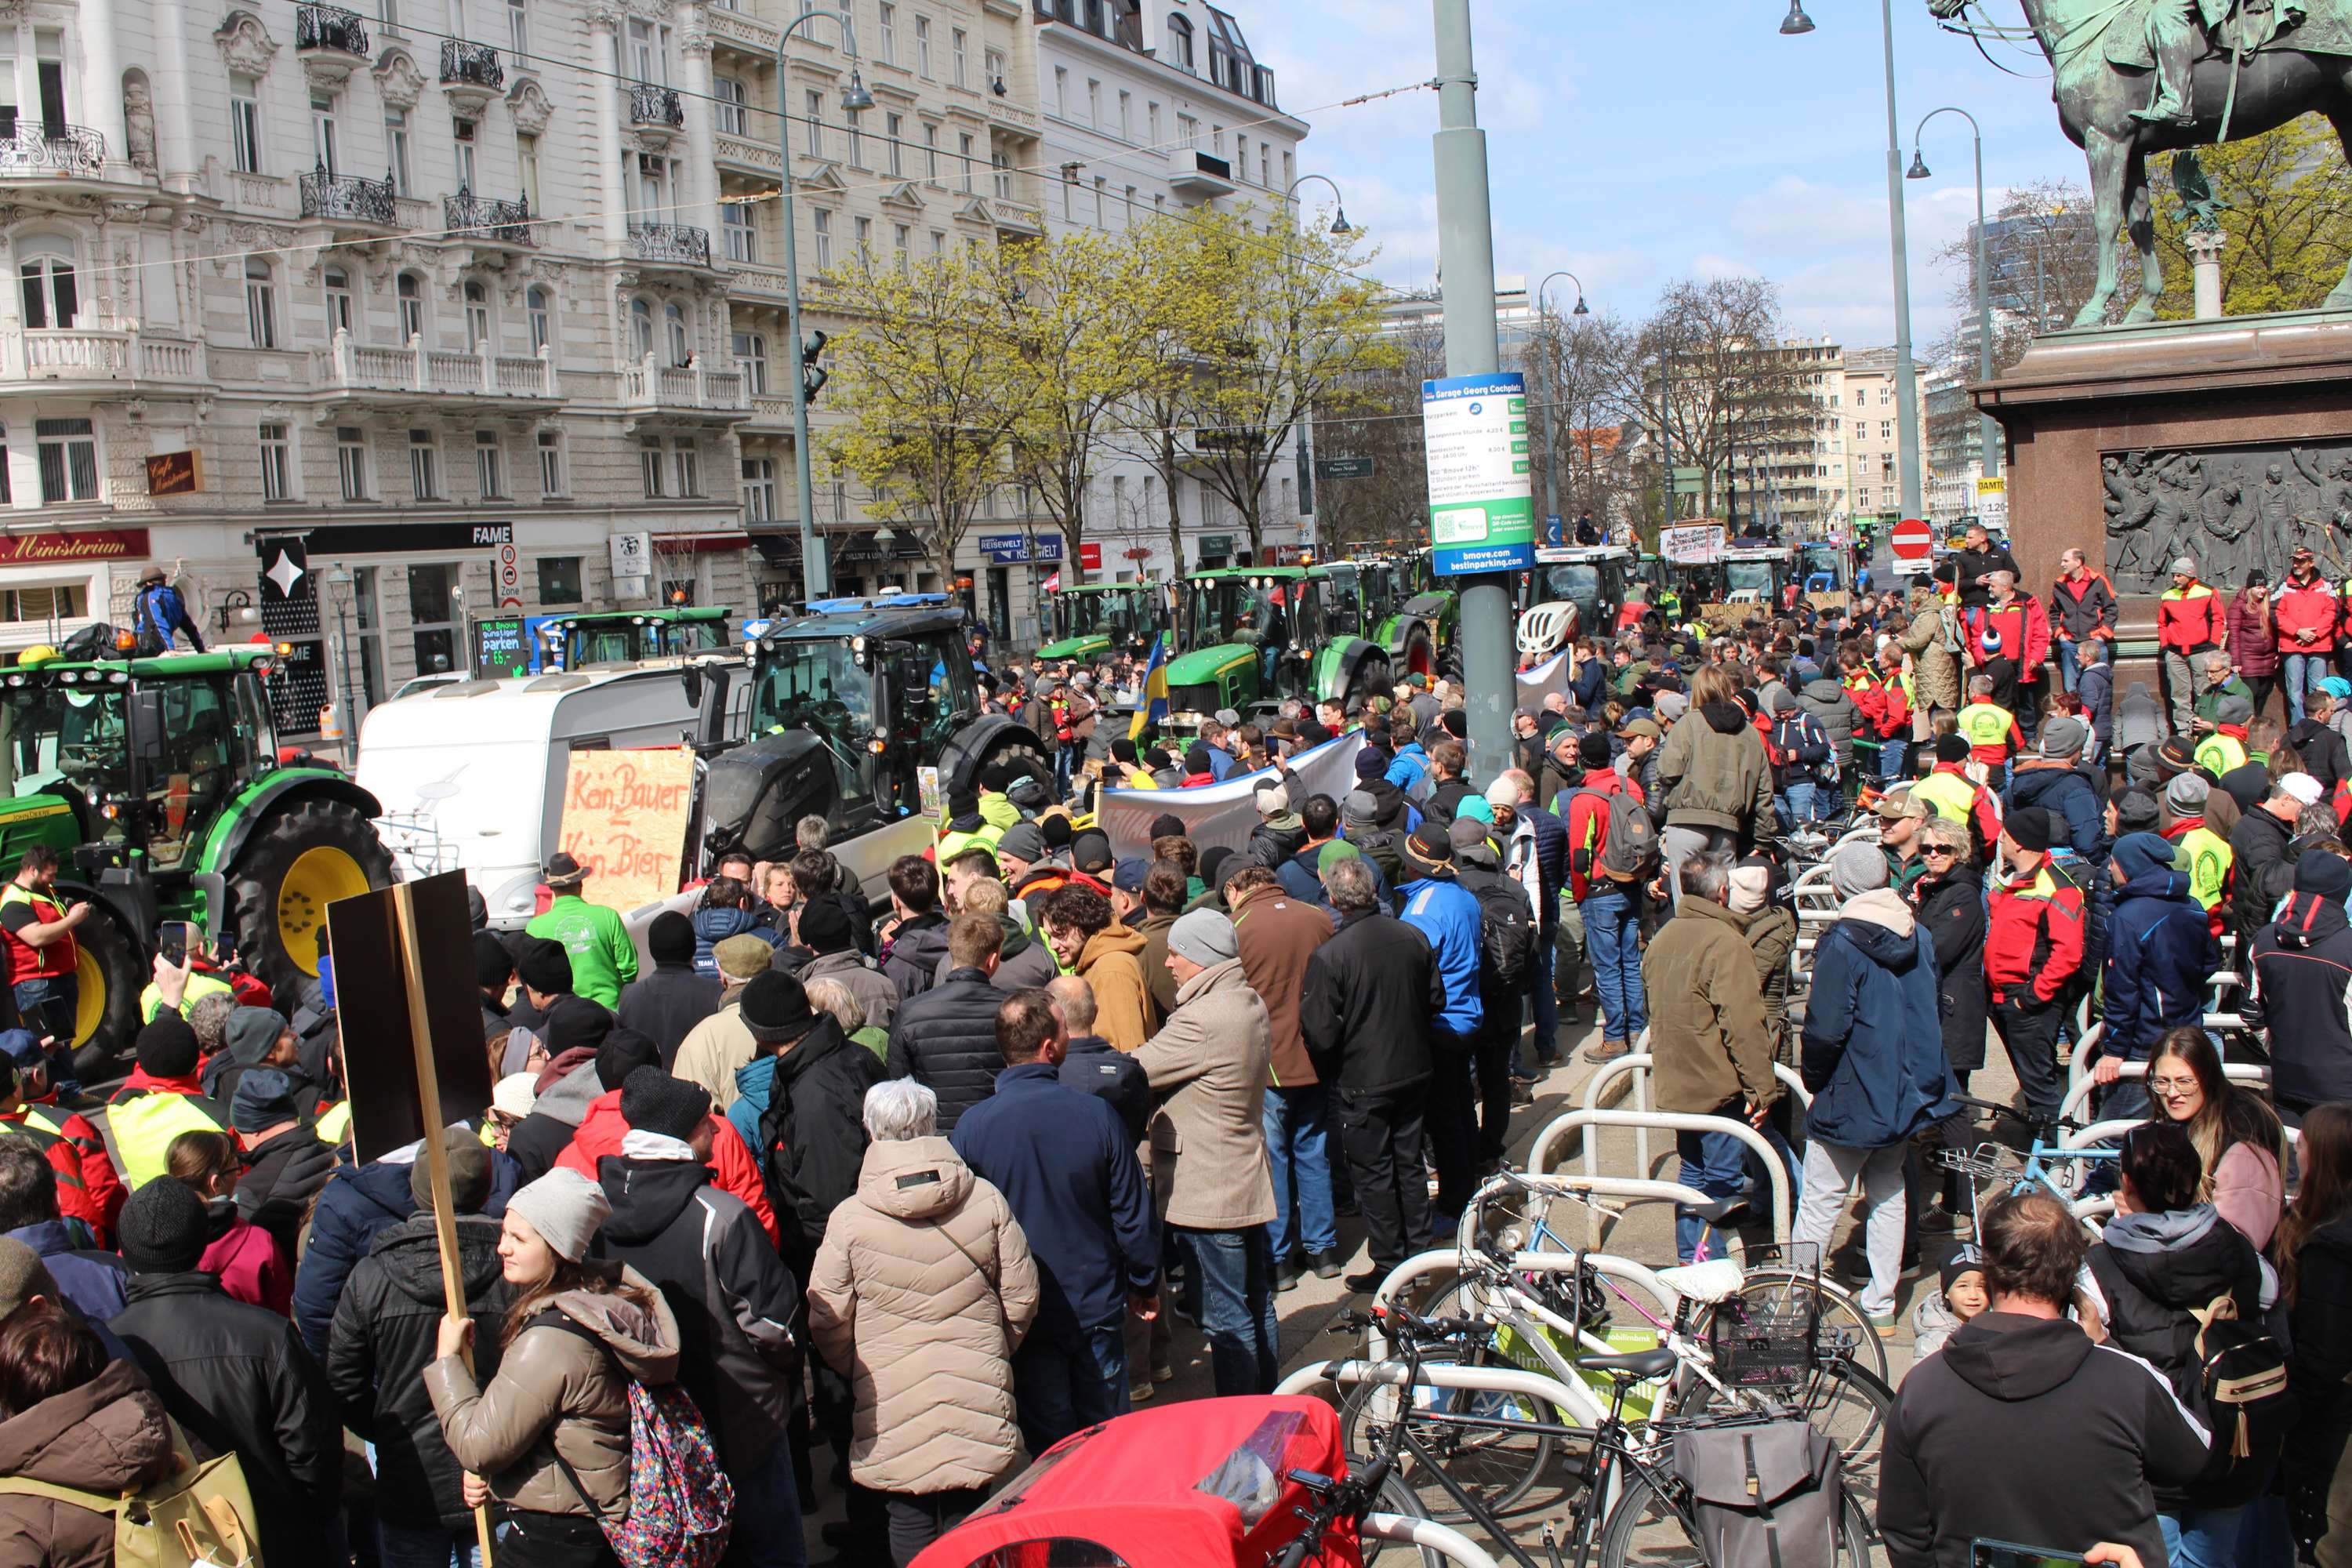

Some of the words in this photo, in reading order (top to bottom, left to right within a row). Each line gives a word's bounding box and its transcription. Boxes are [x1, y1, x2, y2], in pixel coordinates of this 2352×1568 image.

[1436, 389, 1462, 399] Garage
[1463, 387, 1488, 396] Georg
[1490, 383, 1521, 393] Cochplatz
[473, 526, 510, 543] FAME
[1, 535, 126, 560] Ministerium
[981, 539, 1022, 550] REISEWELT
[1016, 544, 1058, 559] REIWELT
[504, 550, 512, 560] 30
[1463, 550, 1511, 561] bmove.com
[1450, 557, 1523, 571] bestinparking.com
[501, 586, 520, 596] Zone
[1706, 604, 1734, 616] VOR
[482, 629, 517, 638] günstiger
[483, 637, 520, 652] parken
[290, 646, 311, 662] ME
[569, 769, 615, 811] Kein
[613, 763, 689, 813] Bauer
